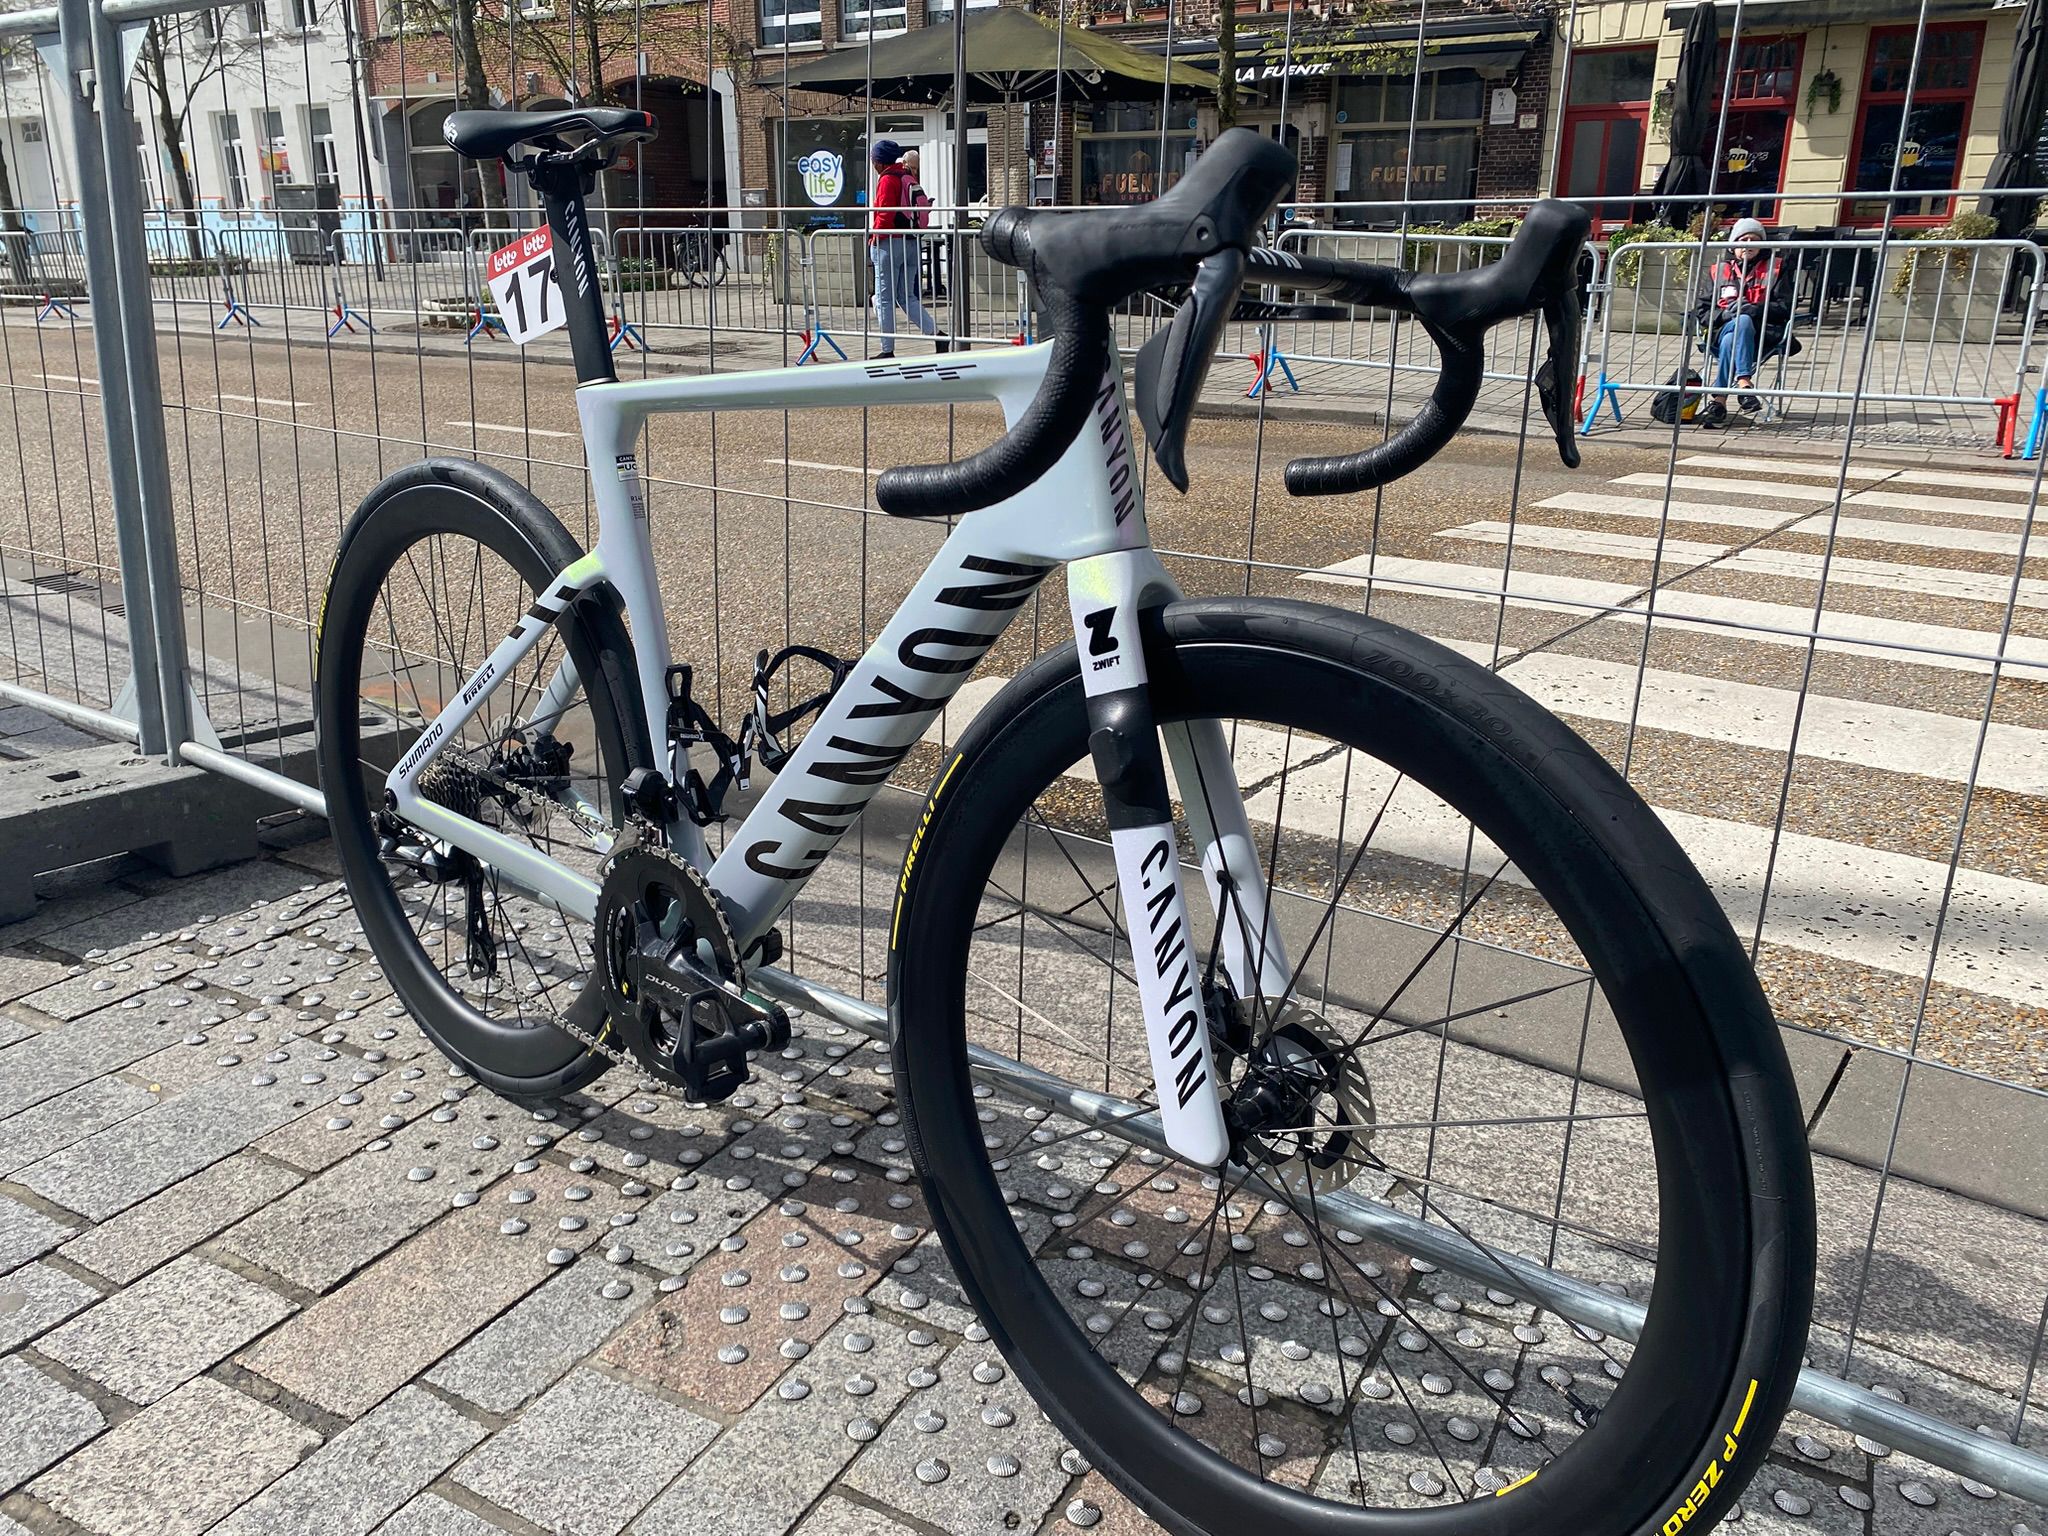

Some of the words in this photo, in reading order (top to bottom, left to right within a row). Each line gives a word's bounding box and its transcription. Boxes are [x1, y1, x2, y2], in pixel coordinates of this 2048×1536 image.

[1235, 67, 1255, 82] LA
[1262, 63, 1332, 79] FUENTE
[799, 157, 842, 178] easy
[809, 173, 835, 197] life
[1370, 165, 1447, 183] FUENTE
[564, 200, 589, 299] CANYON
[504, 254, 552, 335] 17
[1097, 352, 1135, 528] ANYON
[462, 662, 496, 706] PIRELLI
[1092, 655, 1121, 671] ZWIFT
[744, 554, 1062, 880] CANYON
[398, 722, 444, 780] SHIMANO
[900, 799, 936, 894] PIRELLI
[645, 973, 711, 1010] DURA-AE
[1140, 839, 1208, 1111] CANYON
[1722, 1432, 1739, 1463] P
[1662, 1459, 1724, 1536] ZERO
